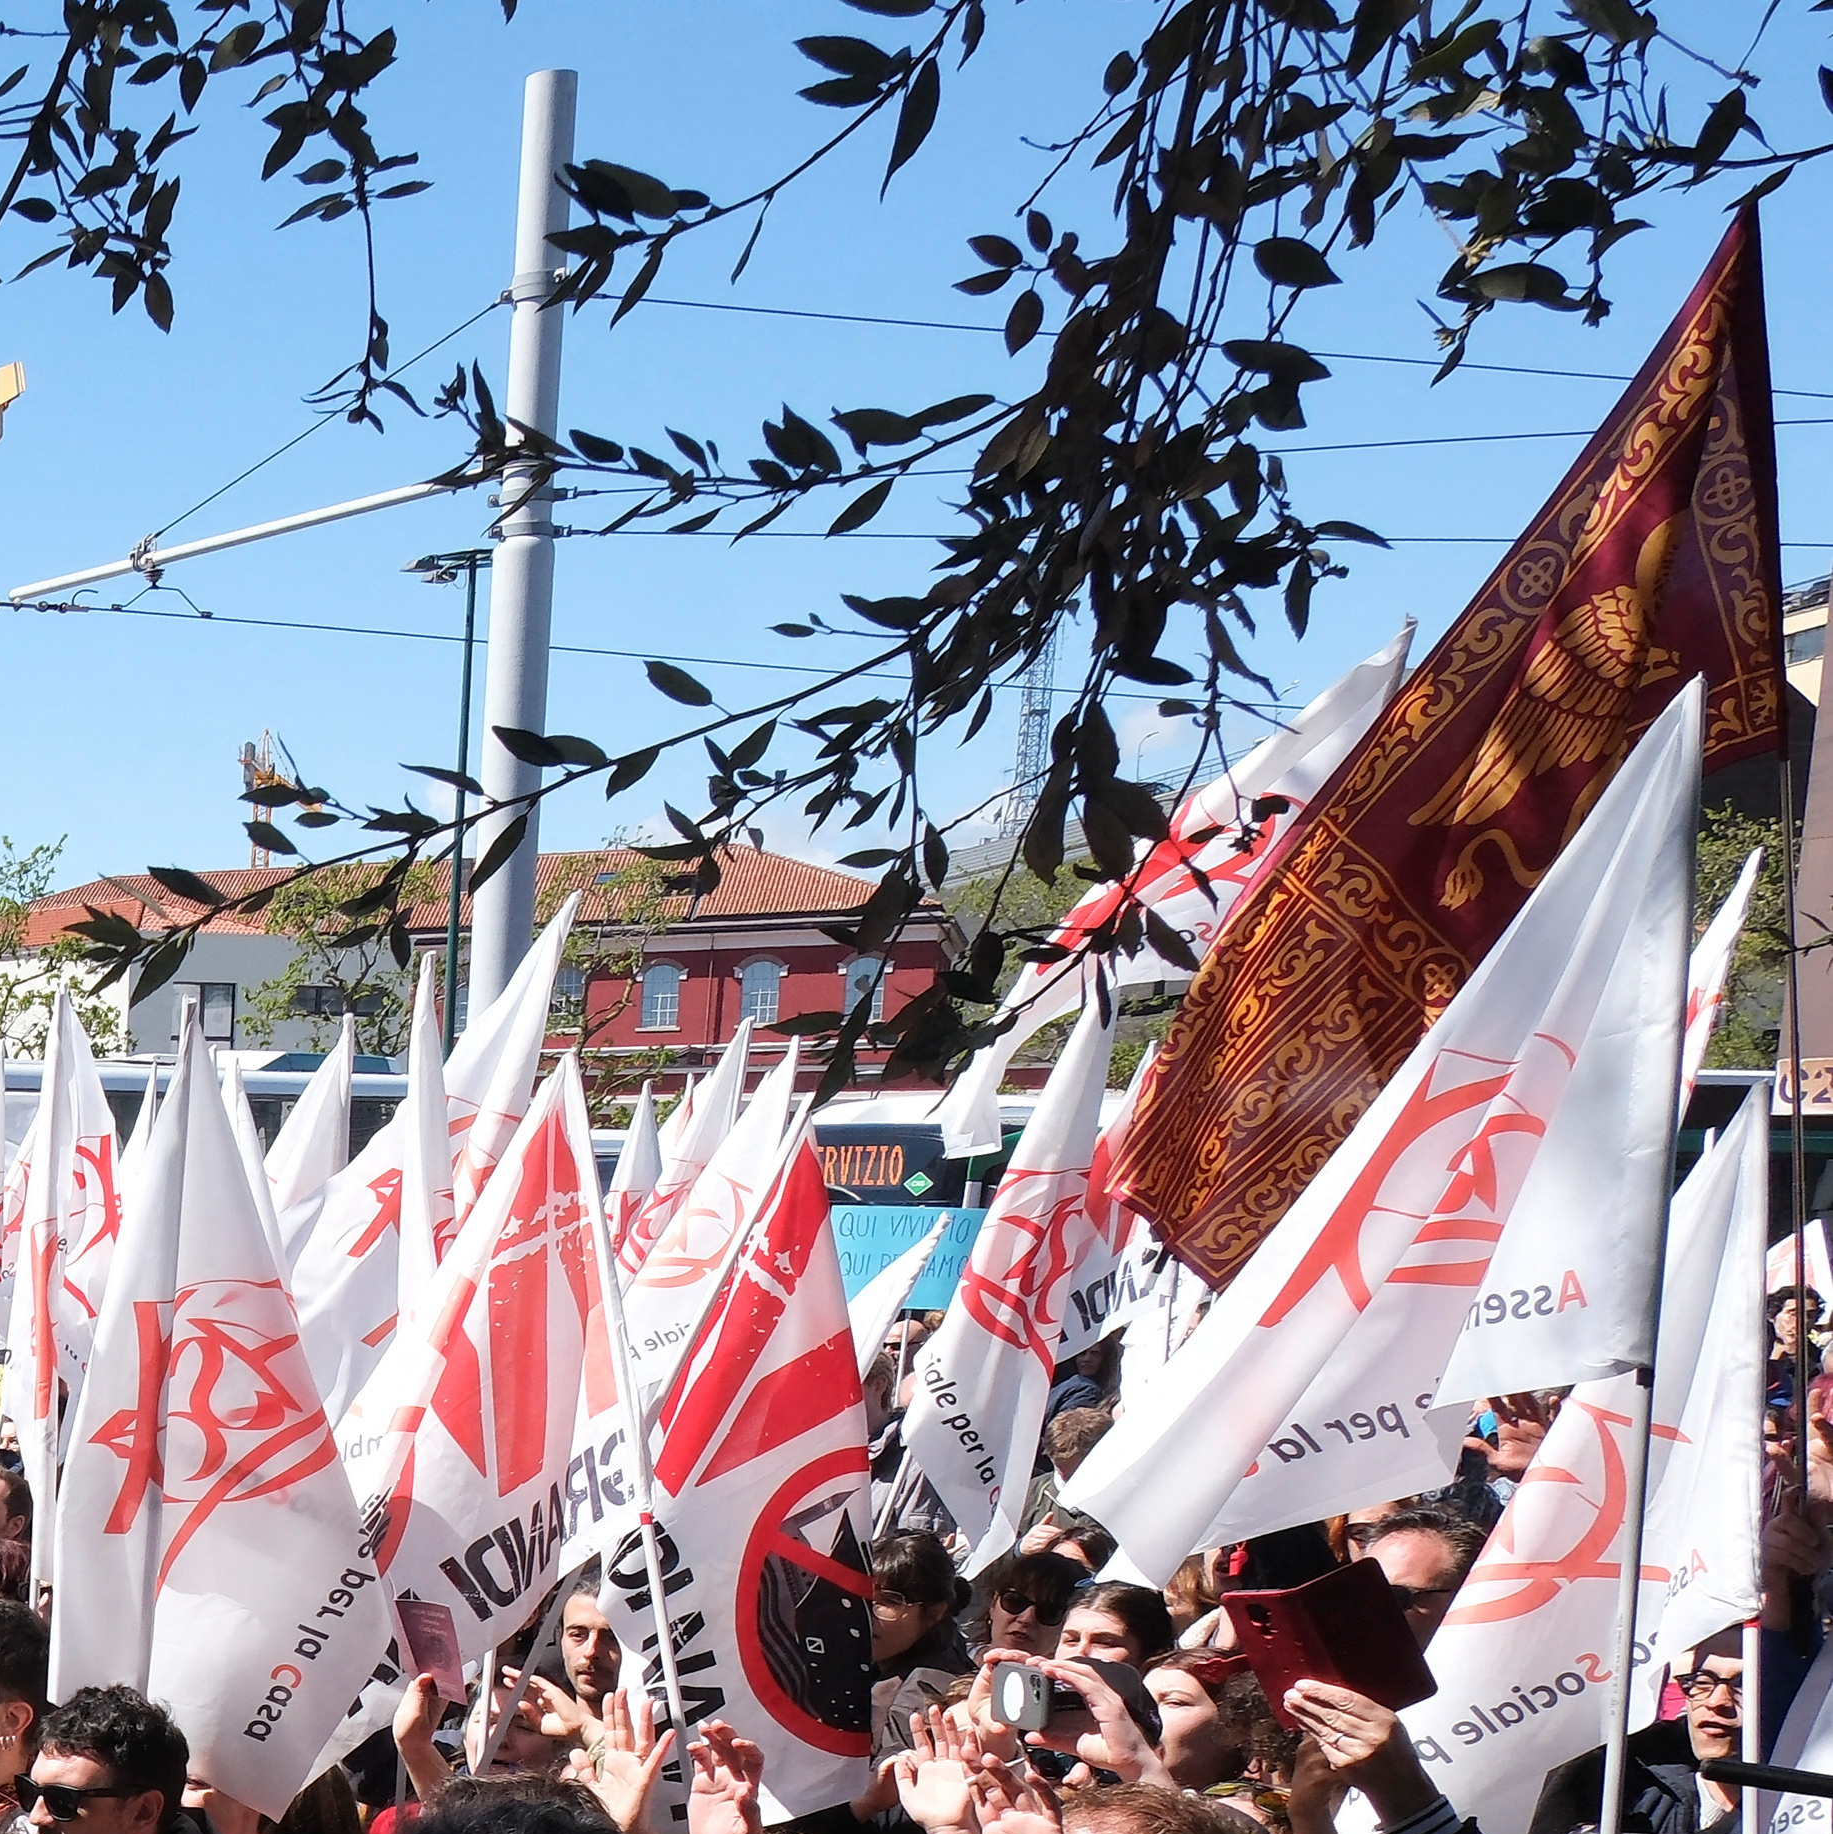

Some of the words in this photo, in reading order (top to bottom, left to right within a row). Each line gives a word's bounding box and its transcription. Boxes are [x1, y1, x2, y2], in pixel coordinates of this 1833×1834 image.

[818, 1145, 905, 1186] RVIZIO
[839, 1211, 877, 1240] QUI
[891, 1214, 971, 1244] VIVIAO
[838, 1251, 870, 1277] QUI
[940, 1413, 985, 1454] per
[974, 1455, 996, 1486] la
